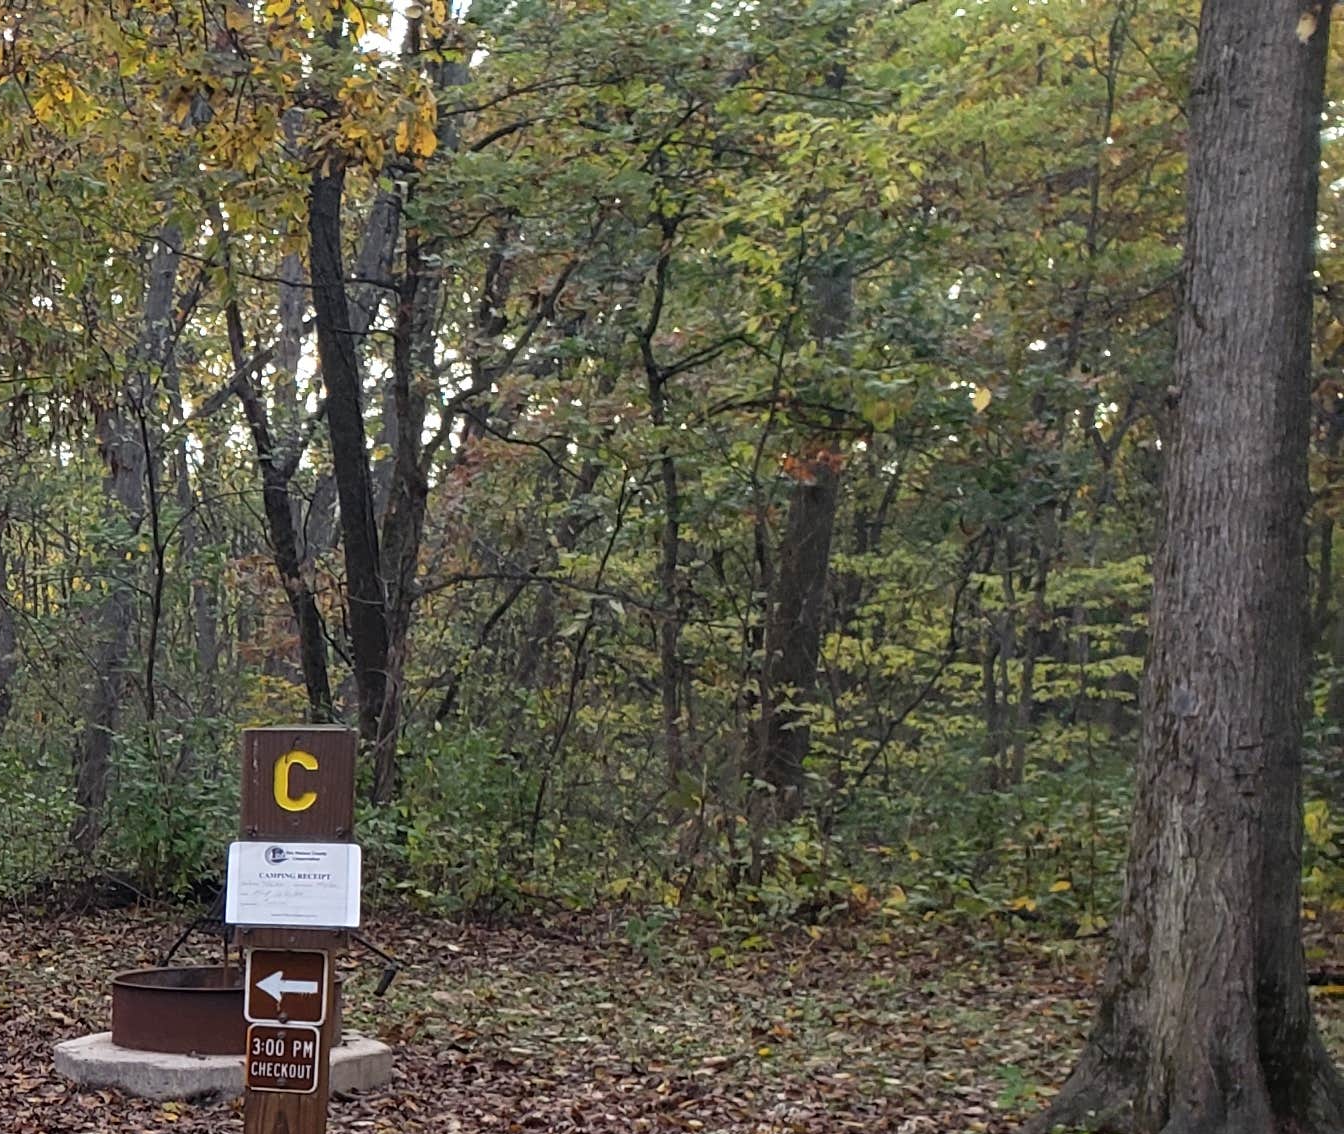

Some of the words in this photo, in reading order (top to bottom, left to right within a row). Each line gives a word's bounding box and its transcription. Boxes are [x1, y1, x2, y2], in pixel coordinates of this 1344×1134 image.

[273, 749, 319, 812] C
[258, 872, 296, 880] CAMPING
[252, 1037, 284, 1057] 3:00
[293, 1040, 313, 1059] PM
[251, 1061, 312, 1080] CHECKOUT
